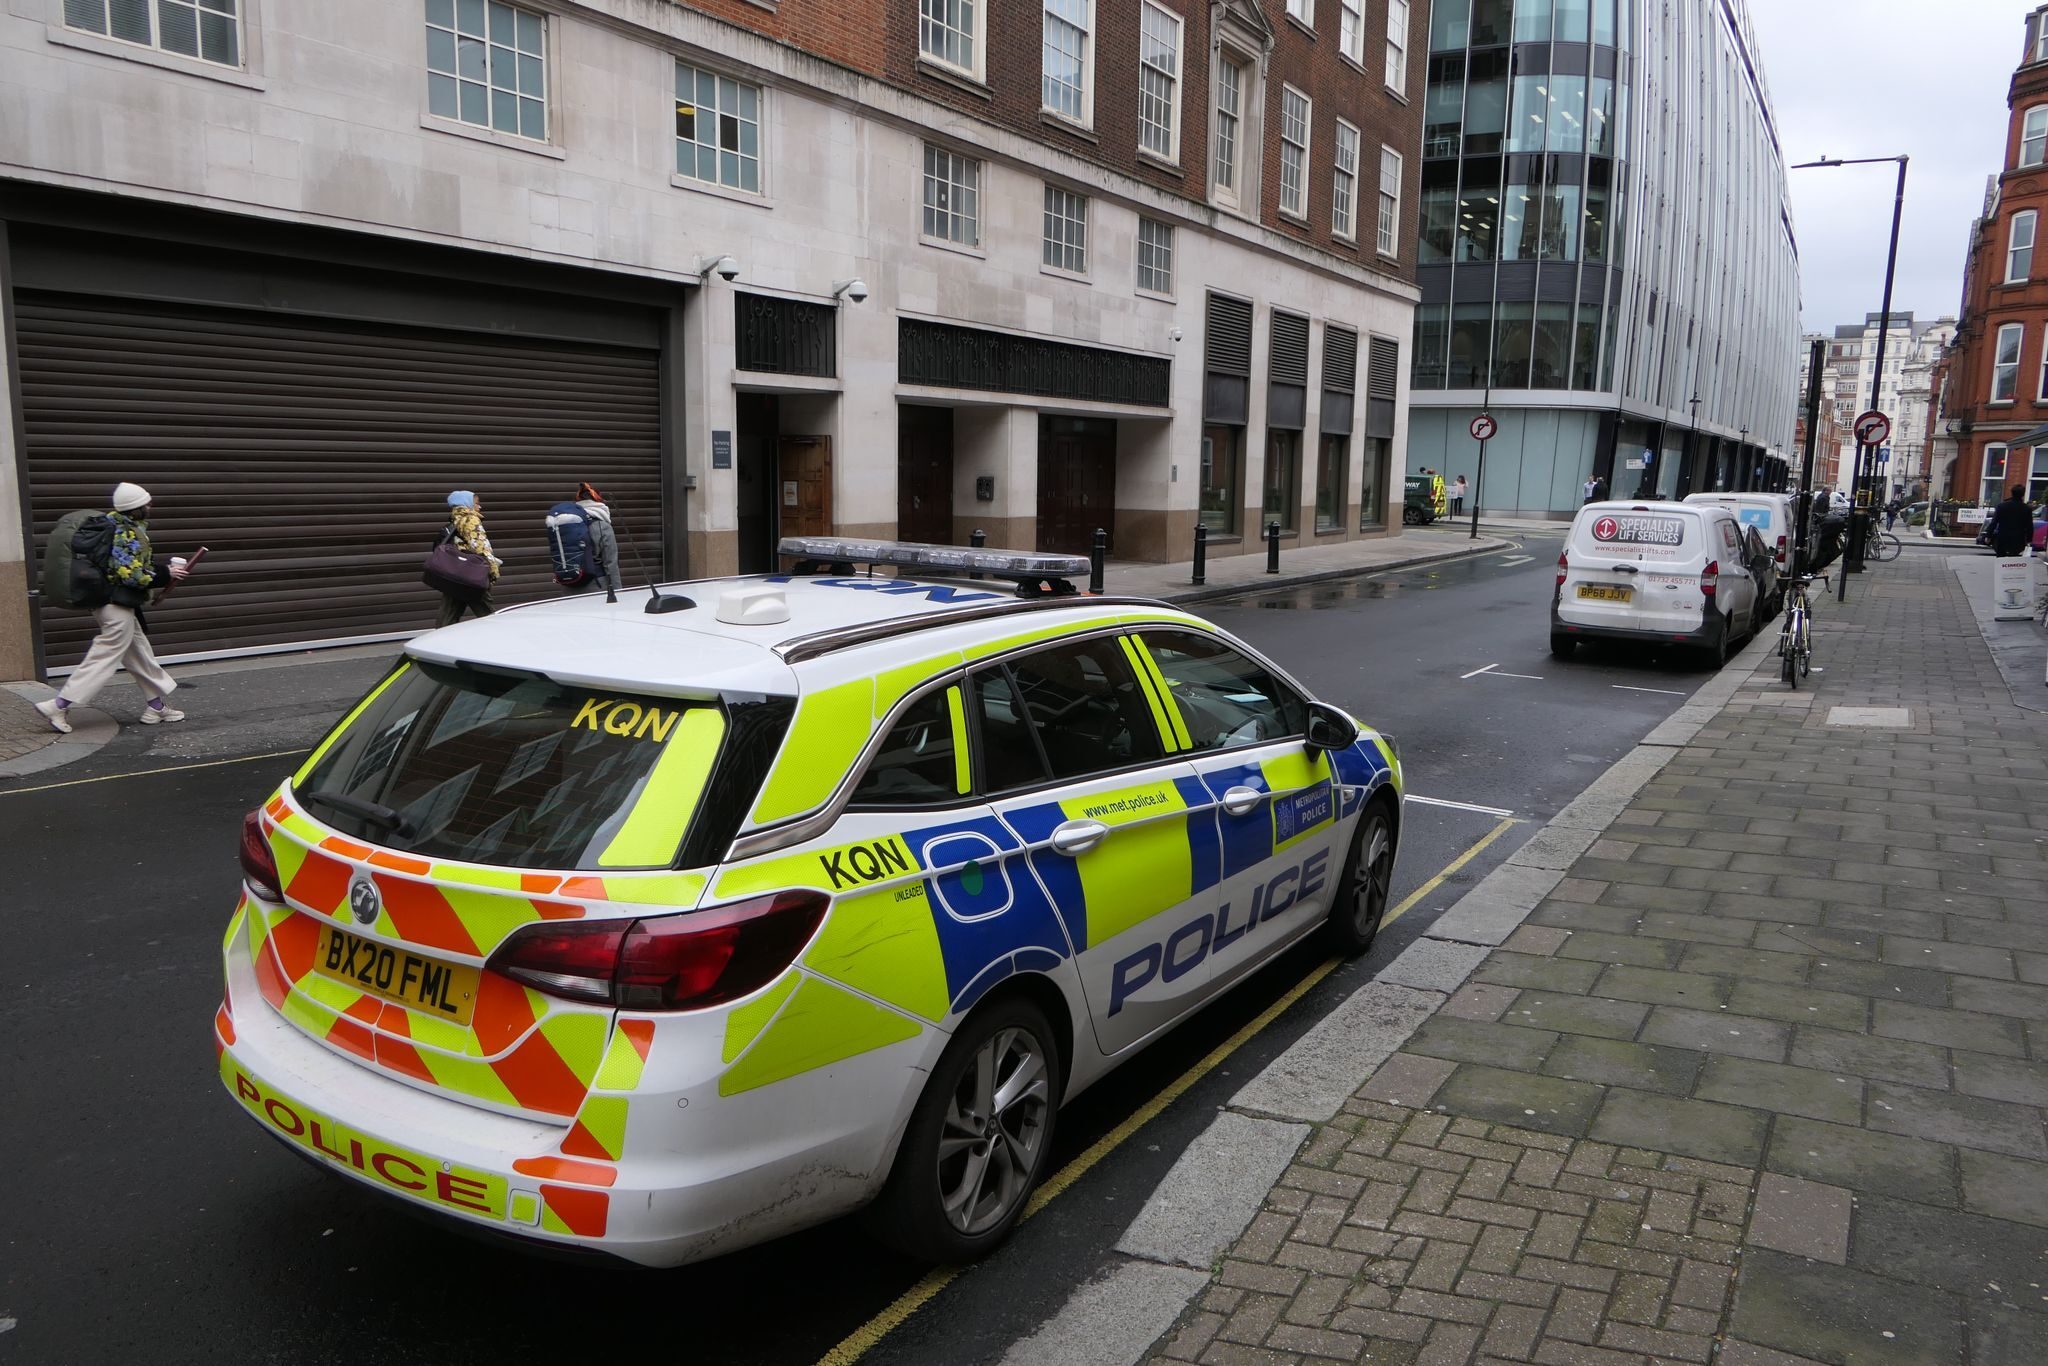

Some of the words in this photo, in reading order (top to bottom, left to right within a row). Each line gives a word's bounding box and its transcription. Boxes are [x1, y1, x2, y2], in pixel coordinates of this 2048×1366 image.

[1618, 529, 1637, 541] LIFT
[1637, 530, 1680, 544] SERVICES
[1619, 518, 1682, 534] SPECIALIST
[1594, 545, 1676, 556] www.specialistlifts.com
[571, 697, 680, 743] KQN
[1083, 790, 1169, 819] www.met.police.uk
[1302, 802, 1327, 824] POLICE
[819, 838, 909, 890] KQN
[893, 885, 924, 902] UNLEADED
[1107, 846, 1330, 1020] POLICE
[325, 929, 396, 990] BX20
[399, 955, 458, 1015] FML
[236, 1071, 492, 1213] POLICE
